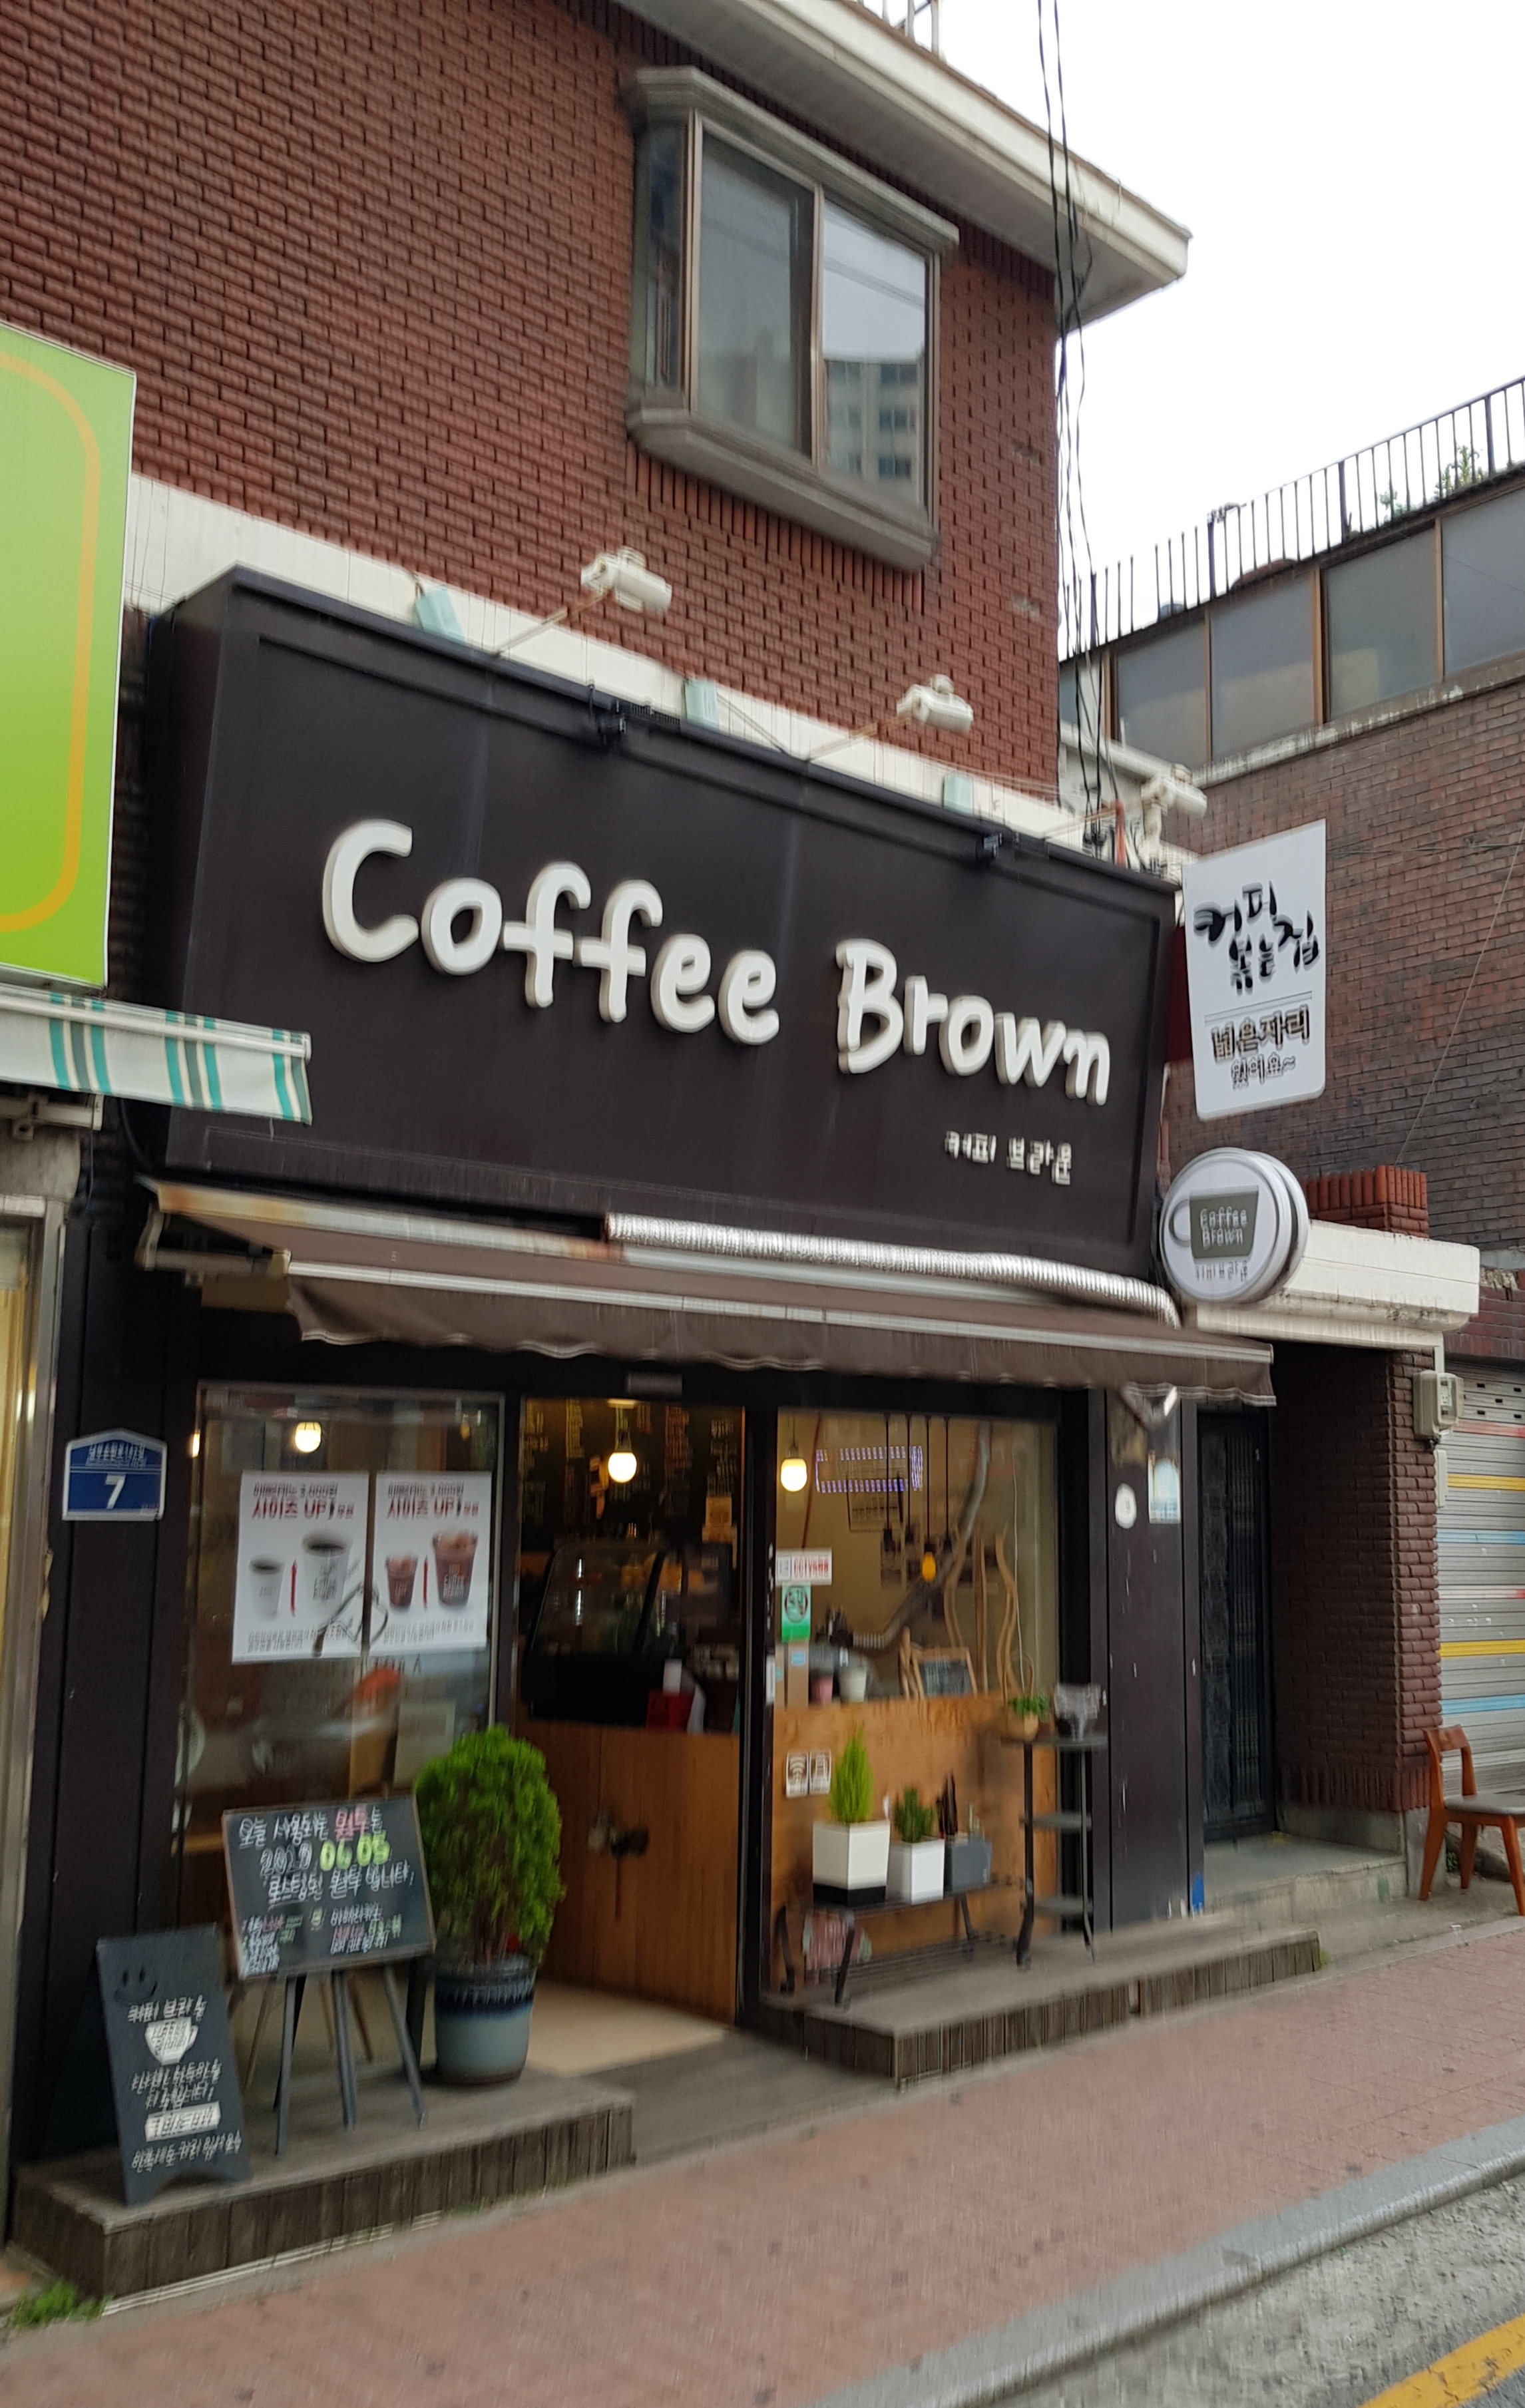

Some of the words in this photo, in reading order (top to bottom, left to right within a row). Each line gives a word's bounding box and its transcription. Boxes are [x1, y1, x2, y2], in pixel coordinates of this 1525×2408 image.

[1194, 880, 1277, 945] 커피
[321, 818, 780, 1046] Coffee
[835, 937, 1111, 1107] Brown
[945, 1130, 997, 1163] 커피
[1006, 1136, 1072, 1185] 브라운
[1200, 1206, 1247, 1229] Coffee
[1202, 1225, 1243, 1251] Brown
[105, 1472, 126, 1510] 7
[252, 1497, 298, 1519] 사이즈
[387, 1498, 429, 1520] 사이즈
